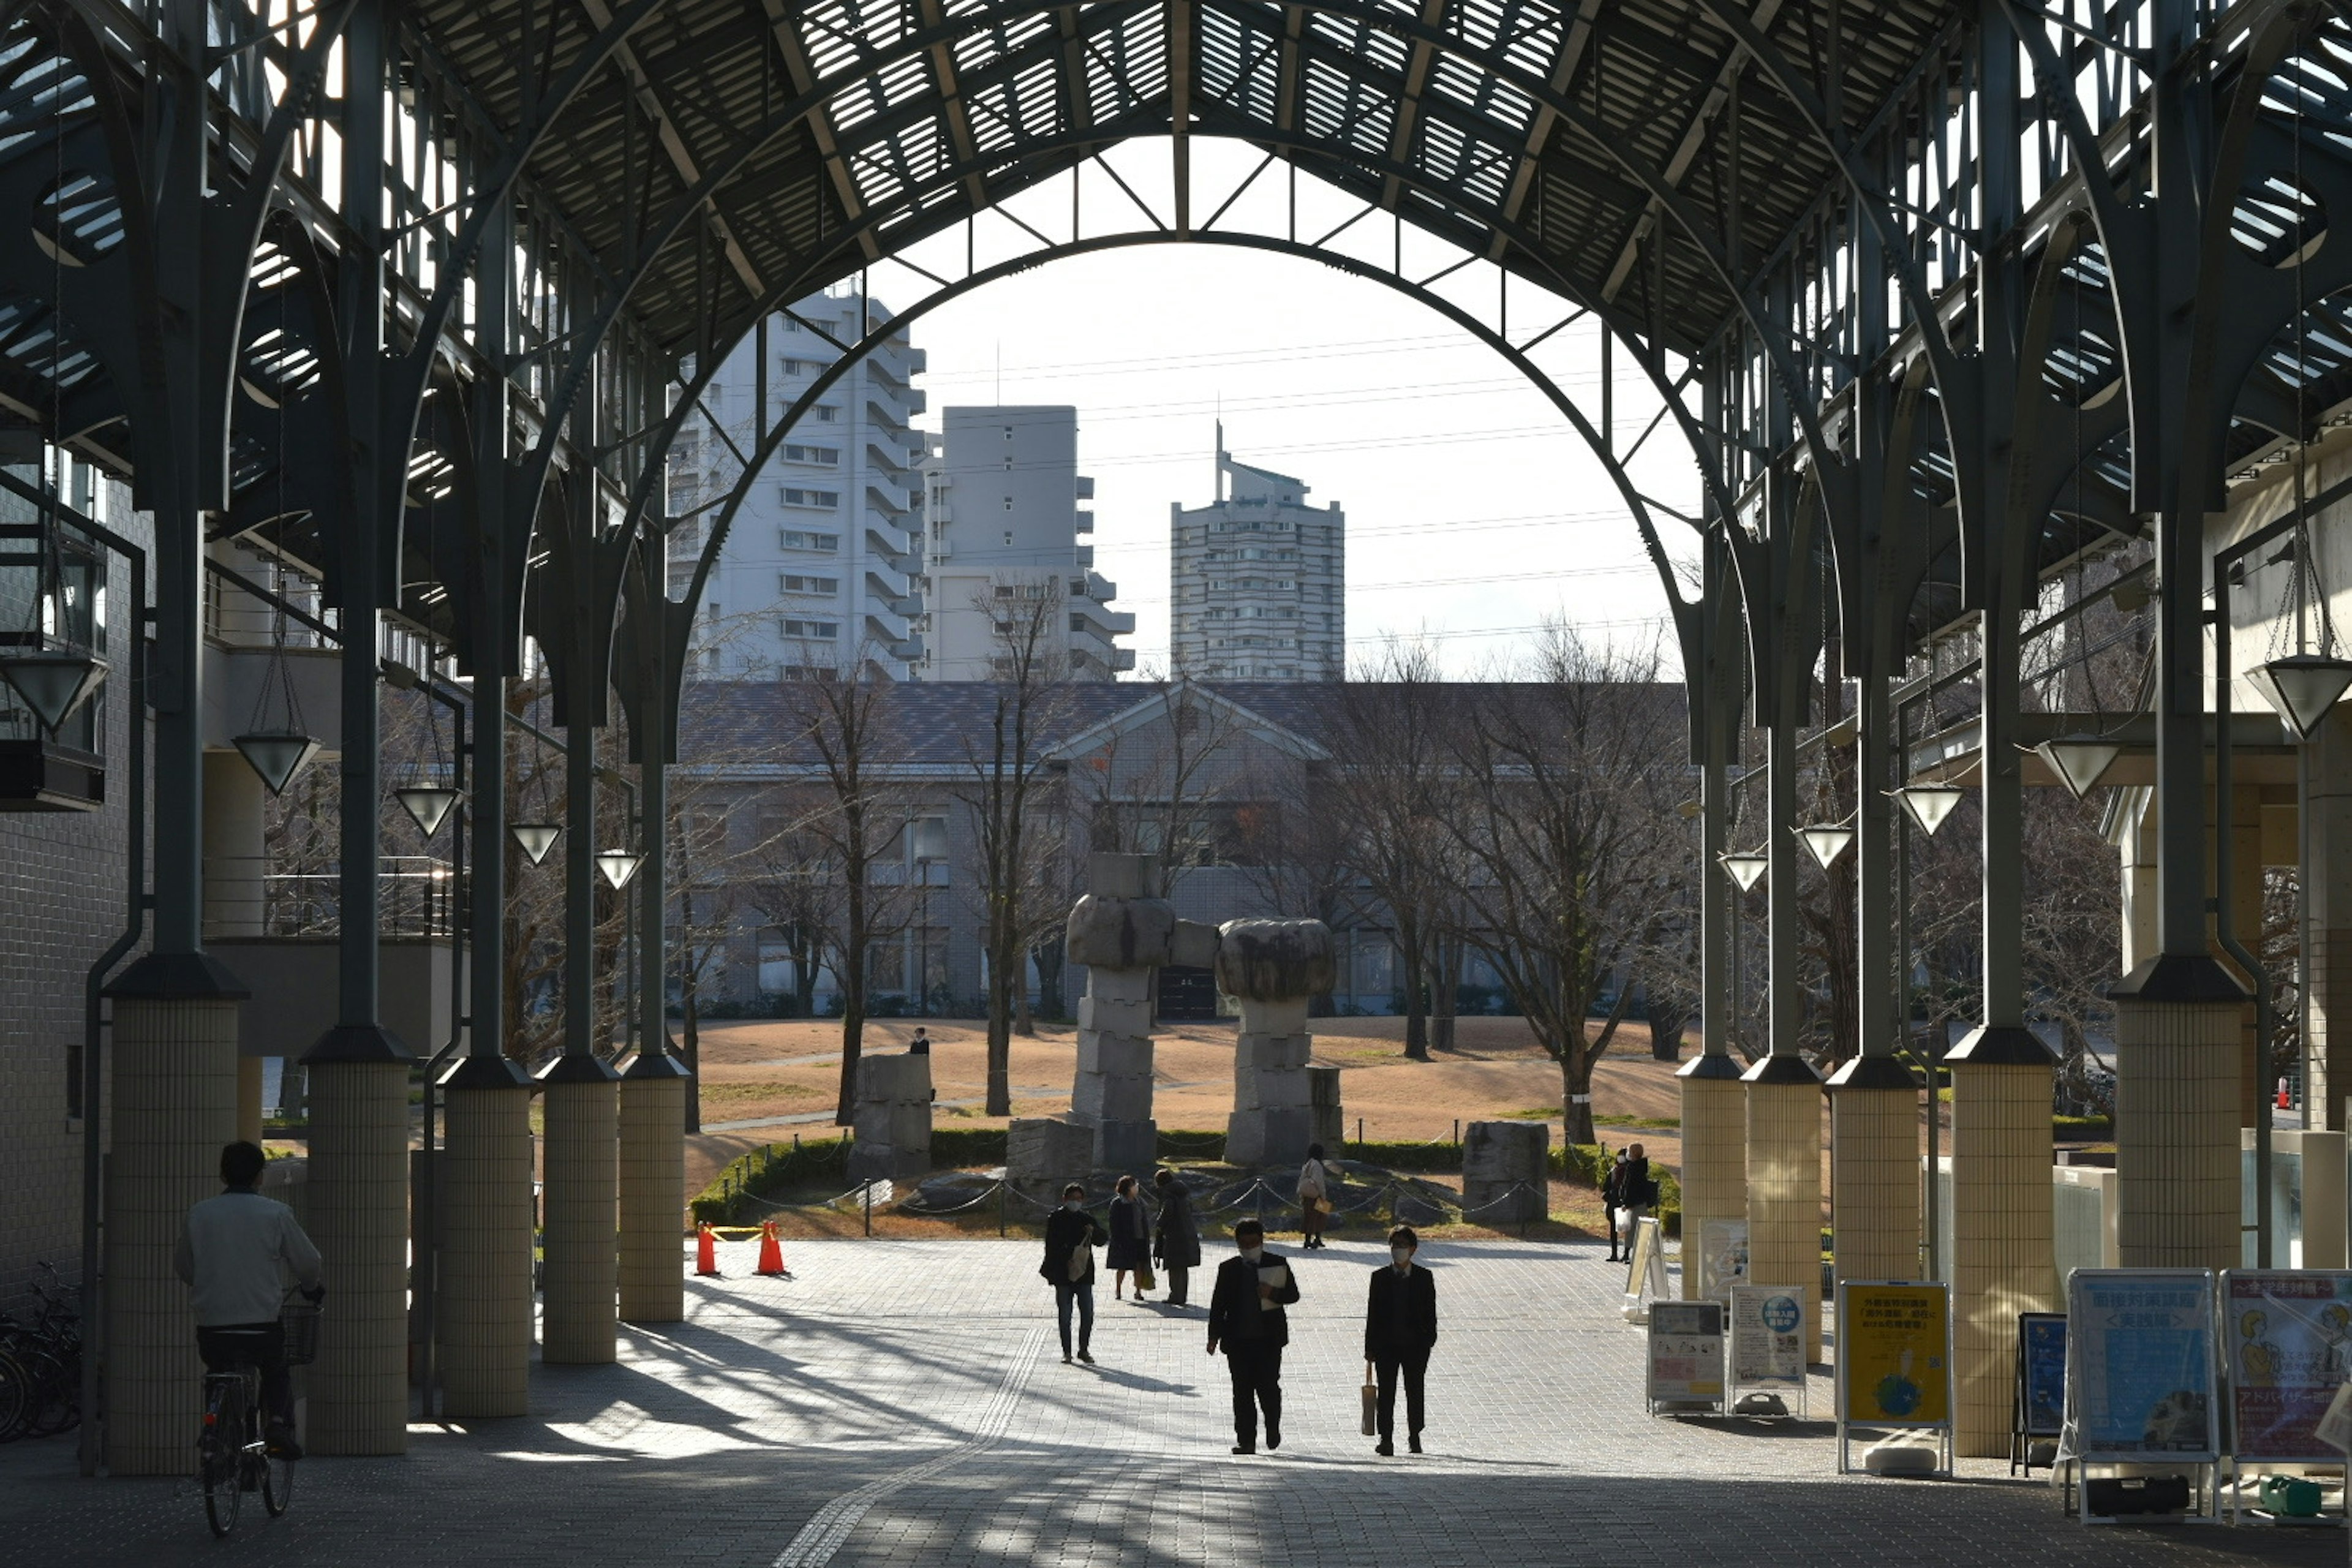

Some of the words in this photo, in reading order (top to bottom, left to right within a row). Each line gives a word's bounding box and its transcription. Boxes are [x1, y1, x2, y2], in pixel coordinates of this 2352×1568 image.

[2092, 1291, 2196, 1308] 面接対策講座
